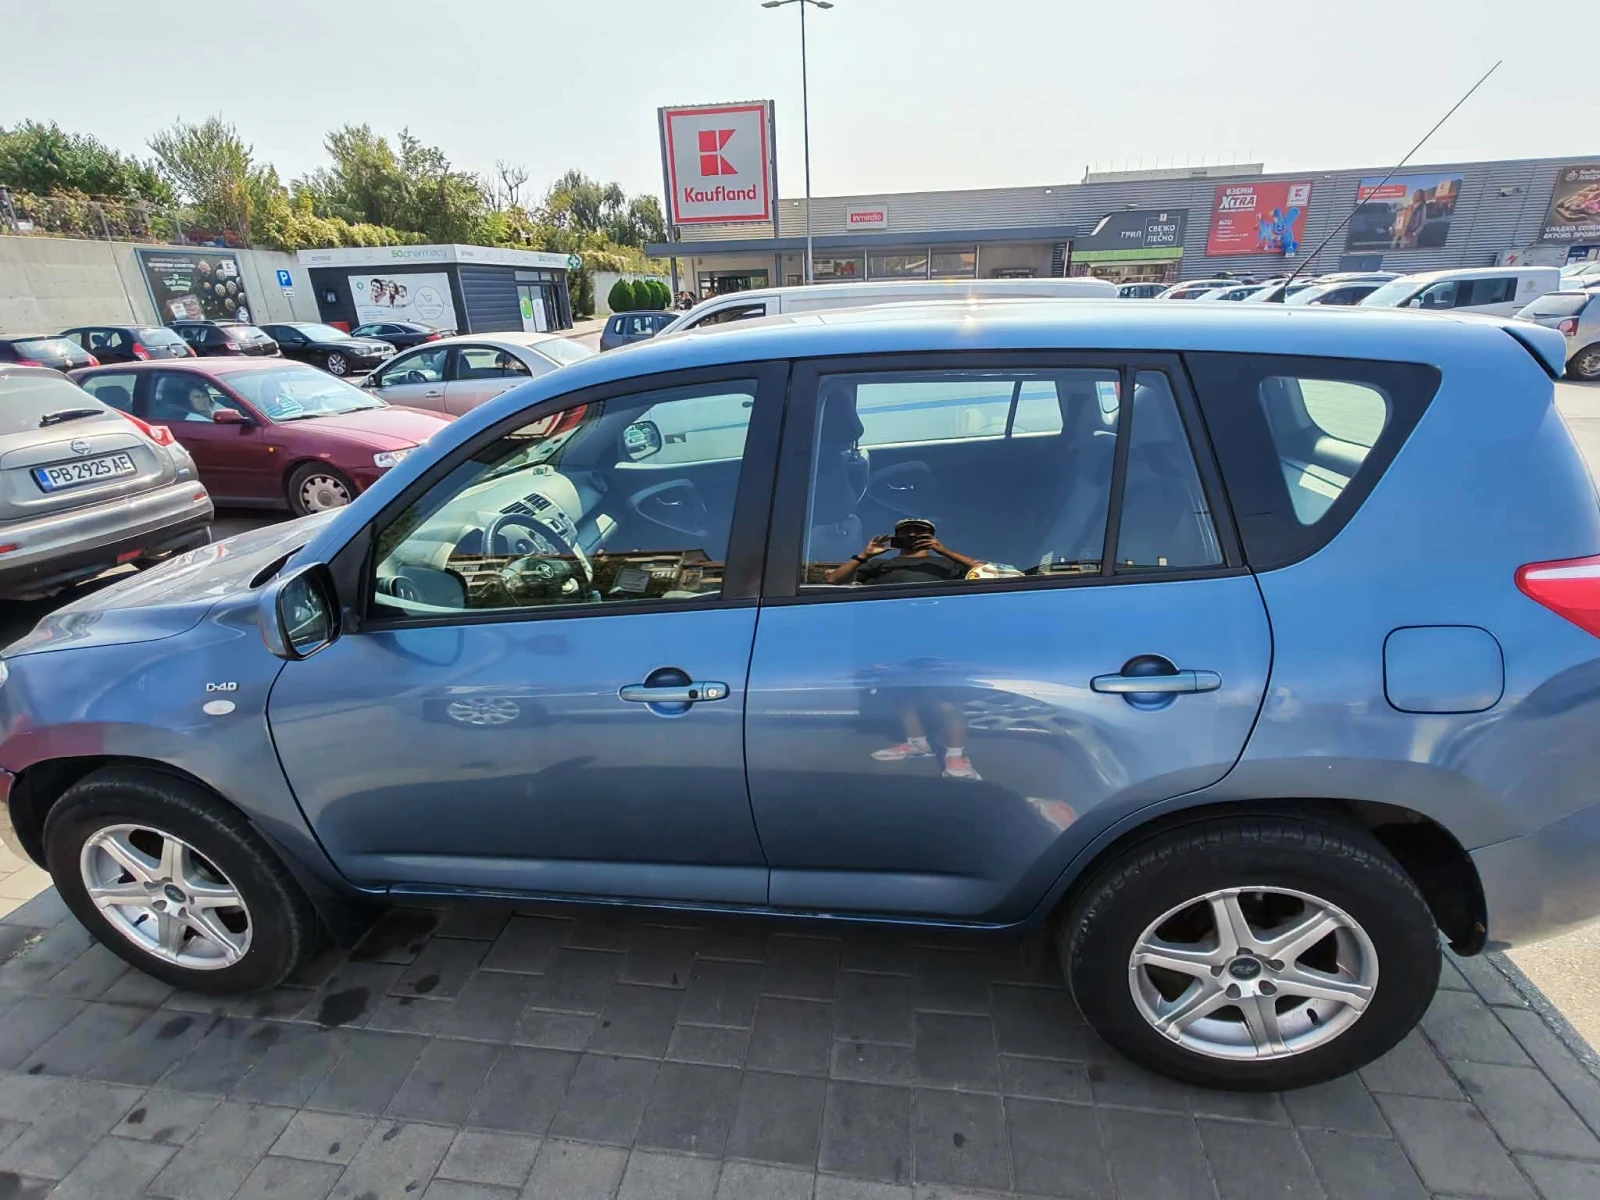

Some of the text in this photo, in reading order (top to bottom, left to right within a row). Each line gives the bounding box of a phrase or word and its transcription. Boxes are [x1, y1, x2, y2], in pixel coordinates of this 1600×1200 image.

[684, 184, 757, 203] Kaufland
[1121, 230, 1142, 238] ГРИЛ
[1148, 224, 1176, 232] СВЕЖО
[279, 271, 288, 285] P
[48, 467, 74, 484] PB
[72, 459, 111, 479] 2925
[112, 456, 132, 473] AE
[206, 681, 238, 692] D-4D
